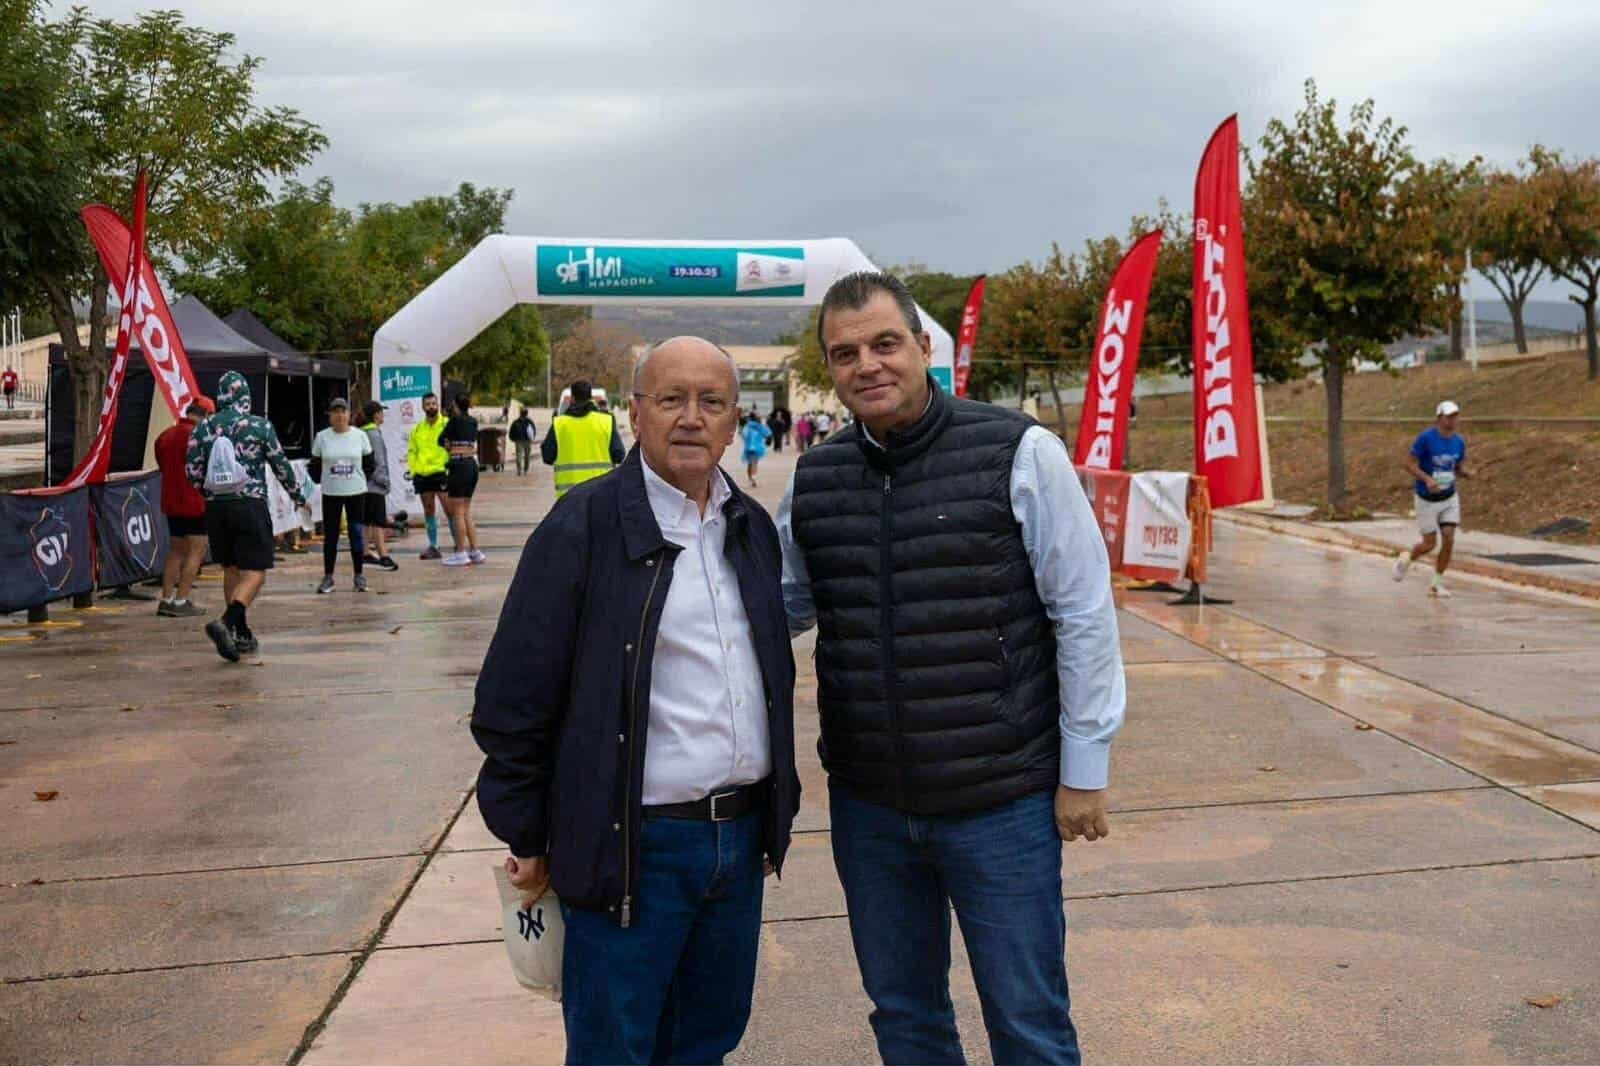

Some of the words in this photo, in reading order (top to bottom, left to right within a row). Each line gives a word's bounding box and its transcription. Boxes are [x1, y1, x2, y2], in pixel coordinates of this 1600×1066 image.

[673, 266, 718, 279] 19.10.25
[1086, 298, 1133, 469] ΒΙΚΟΣ
[127, 514, 151, 544] GU
[517, 906, 545, 942] NY
